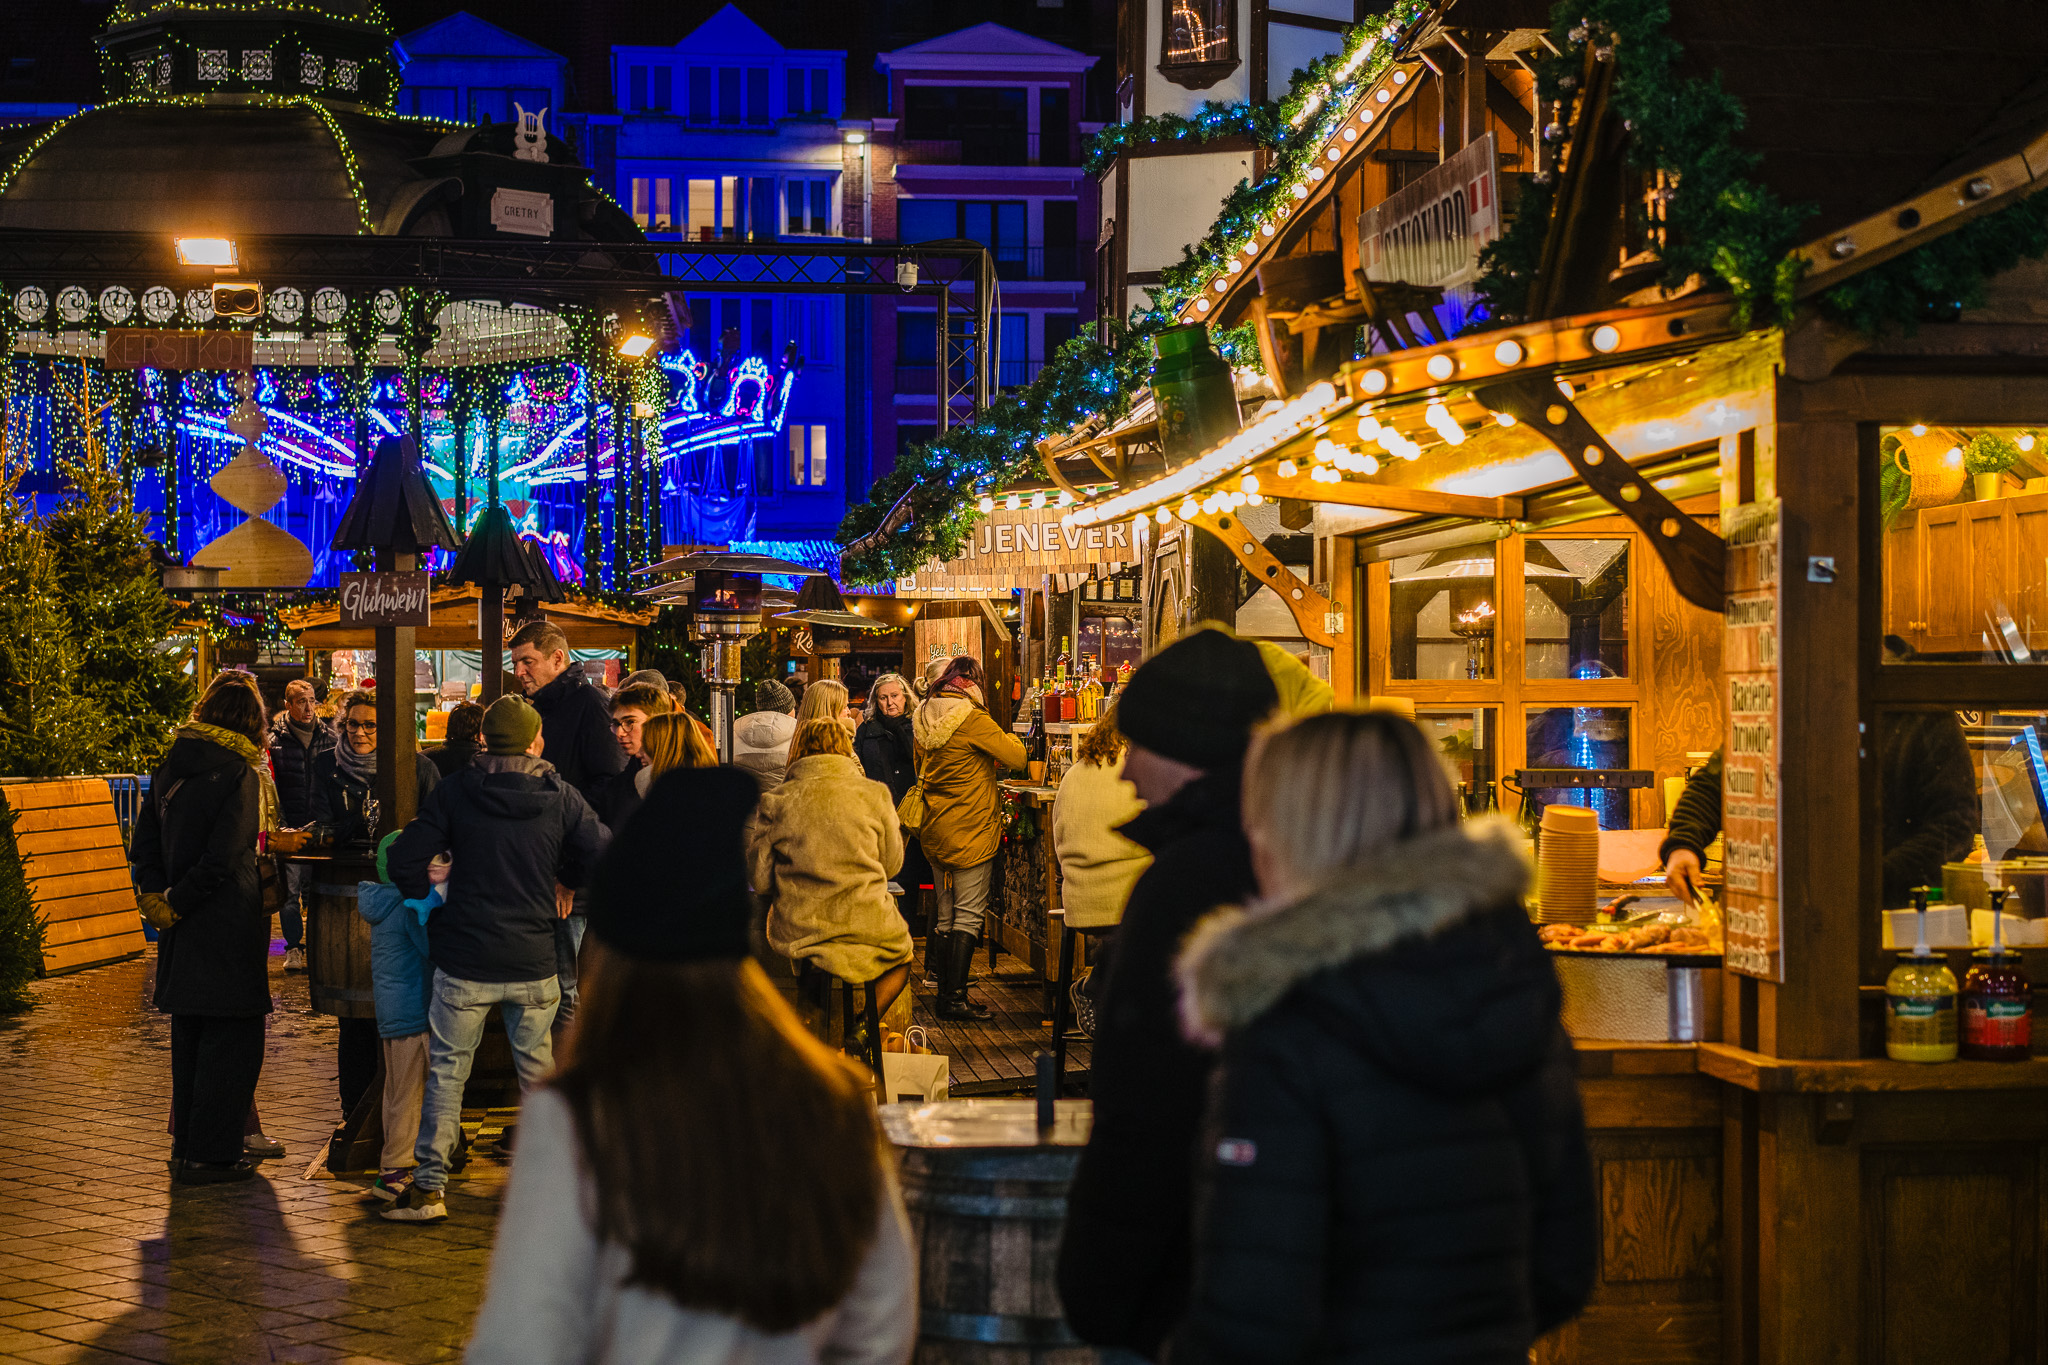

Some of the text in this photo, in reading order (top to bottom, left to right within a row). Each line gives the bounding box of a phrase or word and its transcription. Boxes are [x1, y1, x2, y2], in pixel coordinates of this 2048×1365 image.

[504, 205, 539, 219] GRETRY
[1384, 188, 1467, 285] SAVOYARD
[105, 334, 253, 364] KERSTKOT
[979, 521, 1128, 555] JENEVER
[929, 643, 969, 661] Yeti Bar
